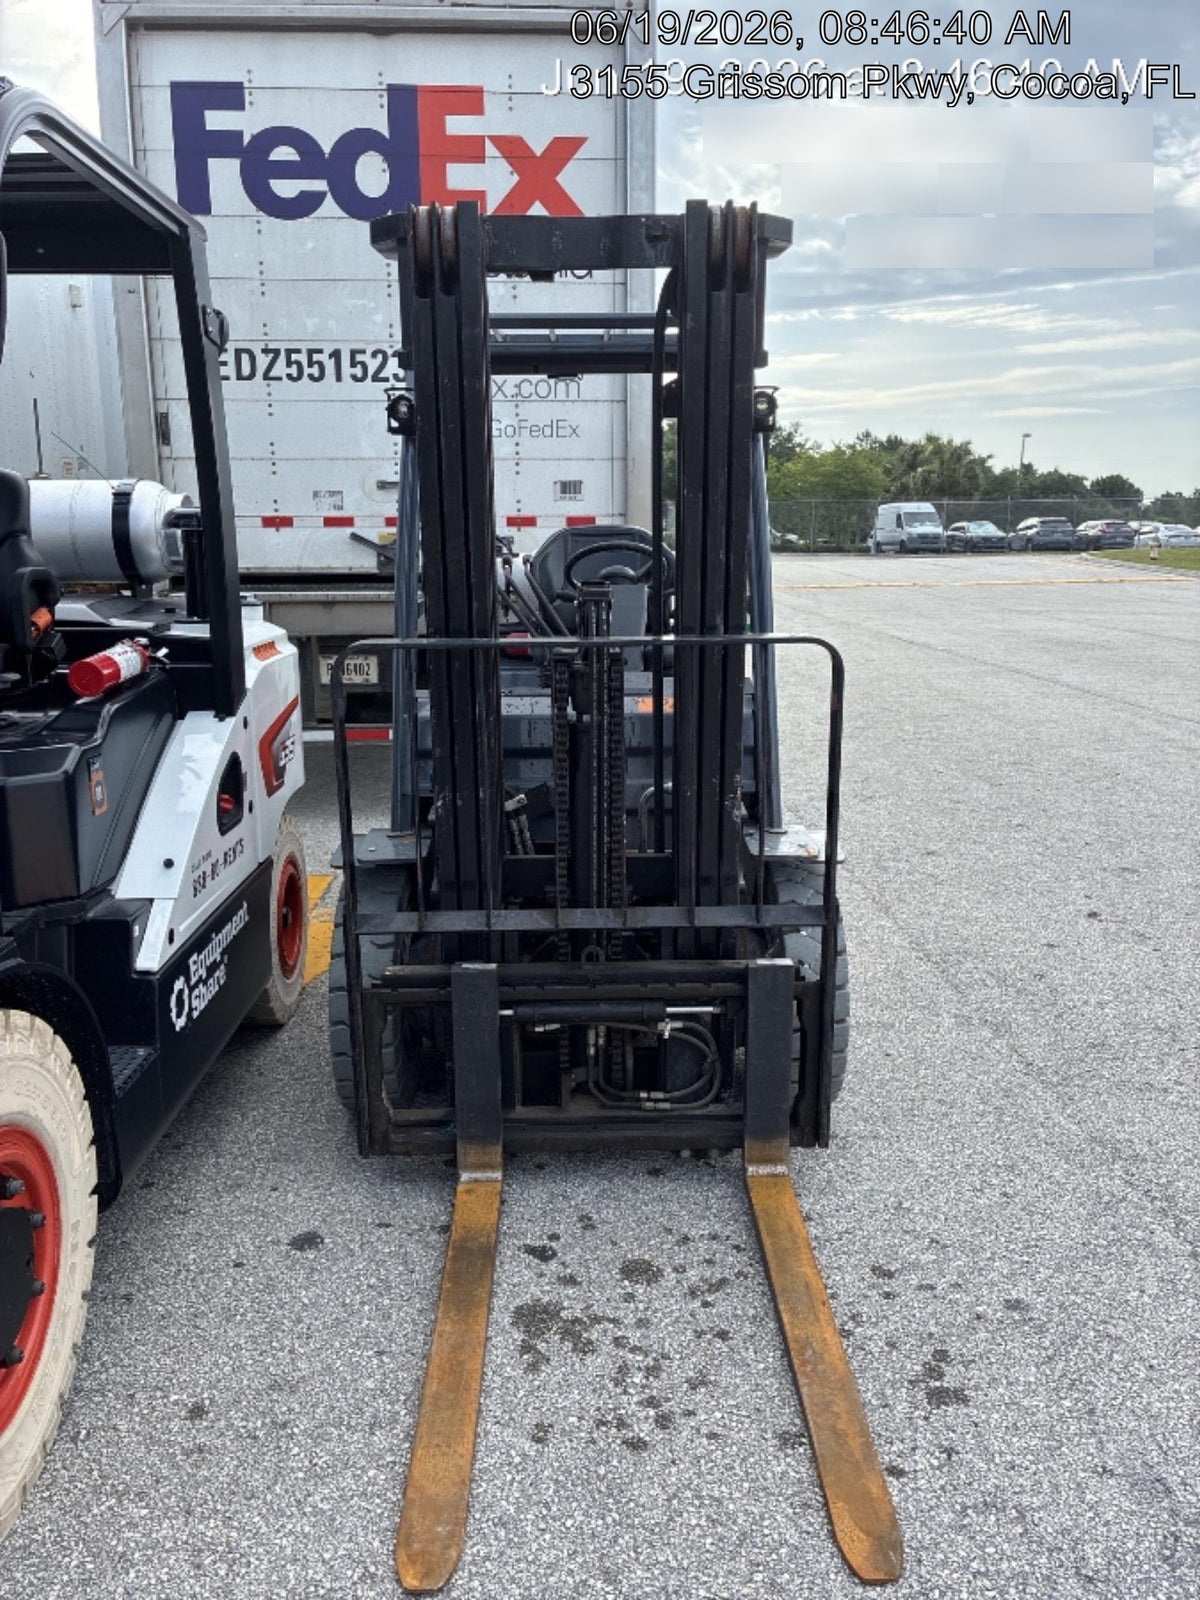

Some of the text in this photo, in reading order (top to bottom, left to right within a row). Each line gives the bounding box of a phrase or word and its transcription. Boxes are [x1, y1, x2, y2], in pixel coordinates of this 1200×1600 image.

[170, 81, 589, 220] FedEx
[188, 900, 250, 986] Equipment
[191, 962, 227, 1019] Share
